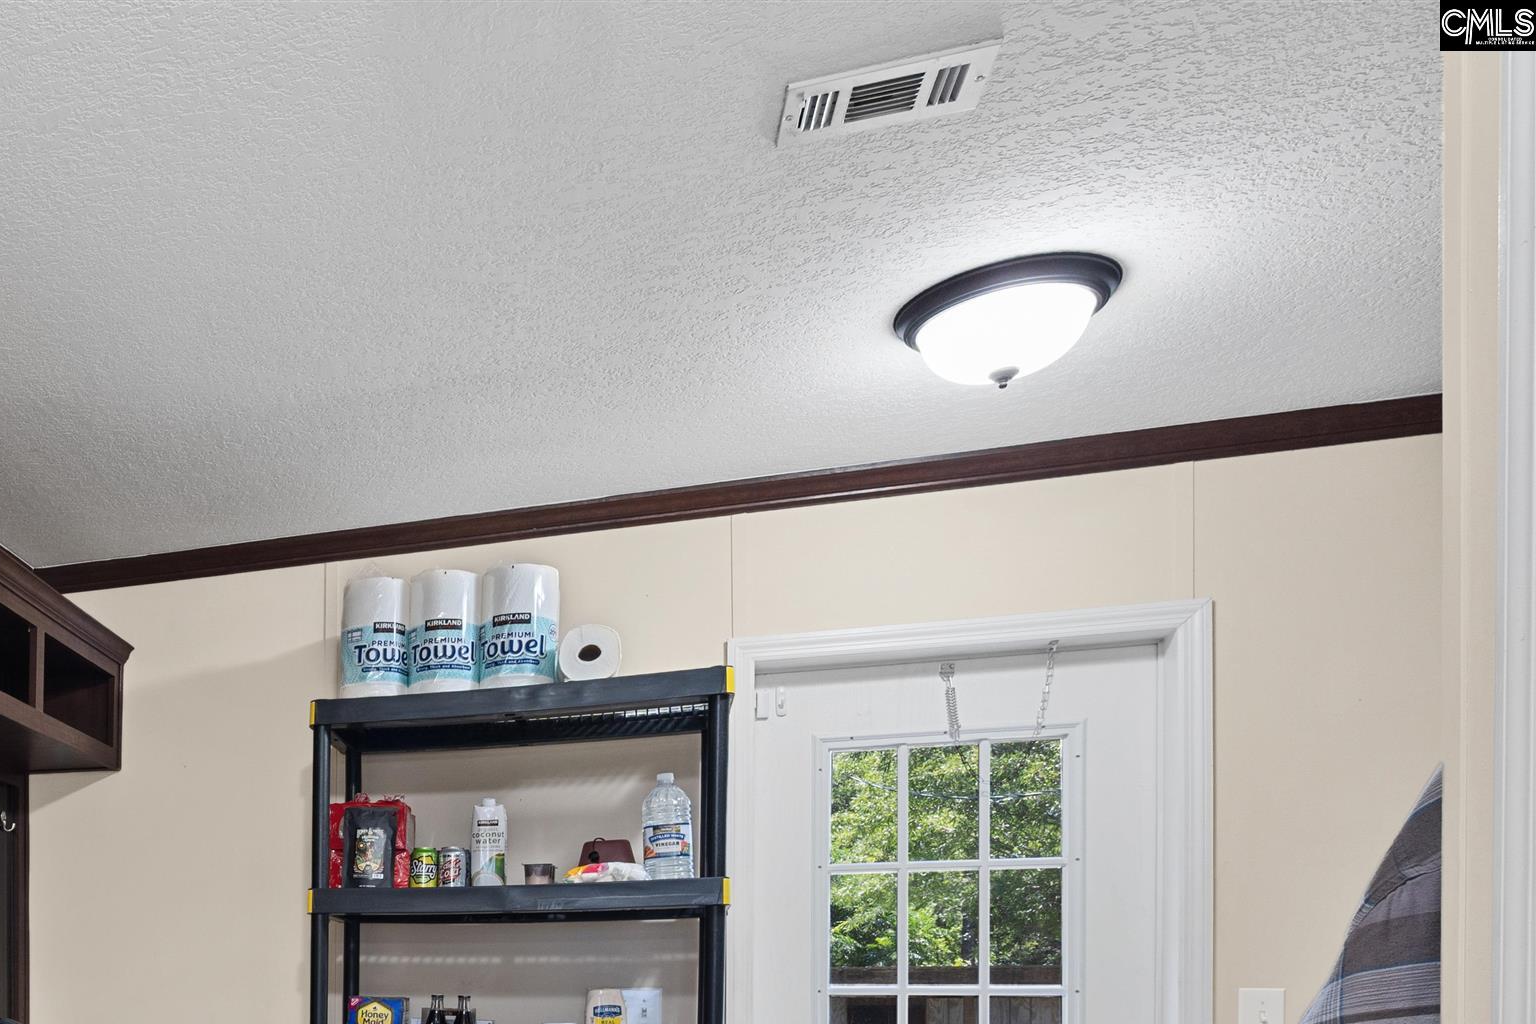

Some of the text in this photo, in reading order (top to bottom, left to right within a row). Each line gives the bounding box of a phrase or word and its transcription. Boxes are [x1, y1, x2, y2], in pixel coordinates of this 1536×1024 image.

[494, 613, 531, 622] KIRKLAND
[424, 637, 463, 645] PREMIUM
[492, 631, 532, 641] PREMIUM
[412, 641, 475, 665] Towel
[481, 635, 545, 661] Towel
[354, 645, 407, 667] Towe
[411, 860, 437, 878] Starry
[361, 1009, 389, 1020] Honey
